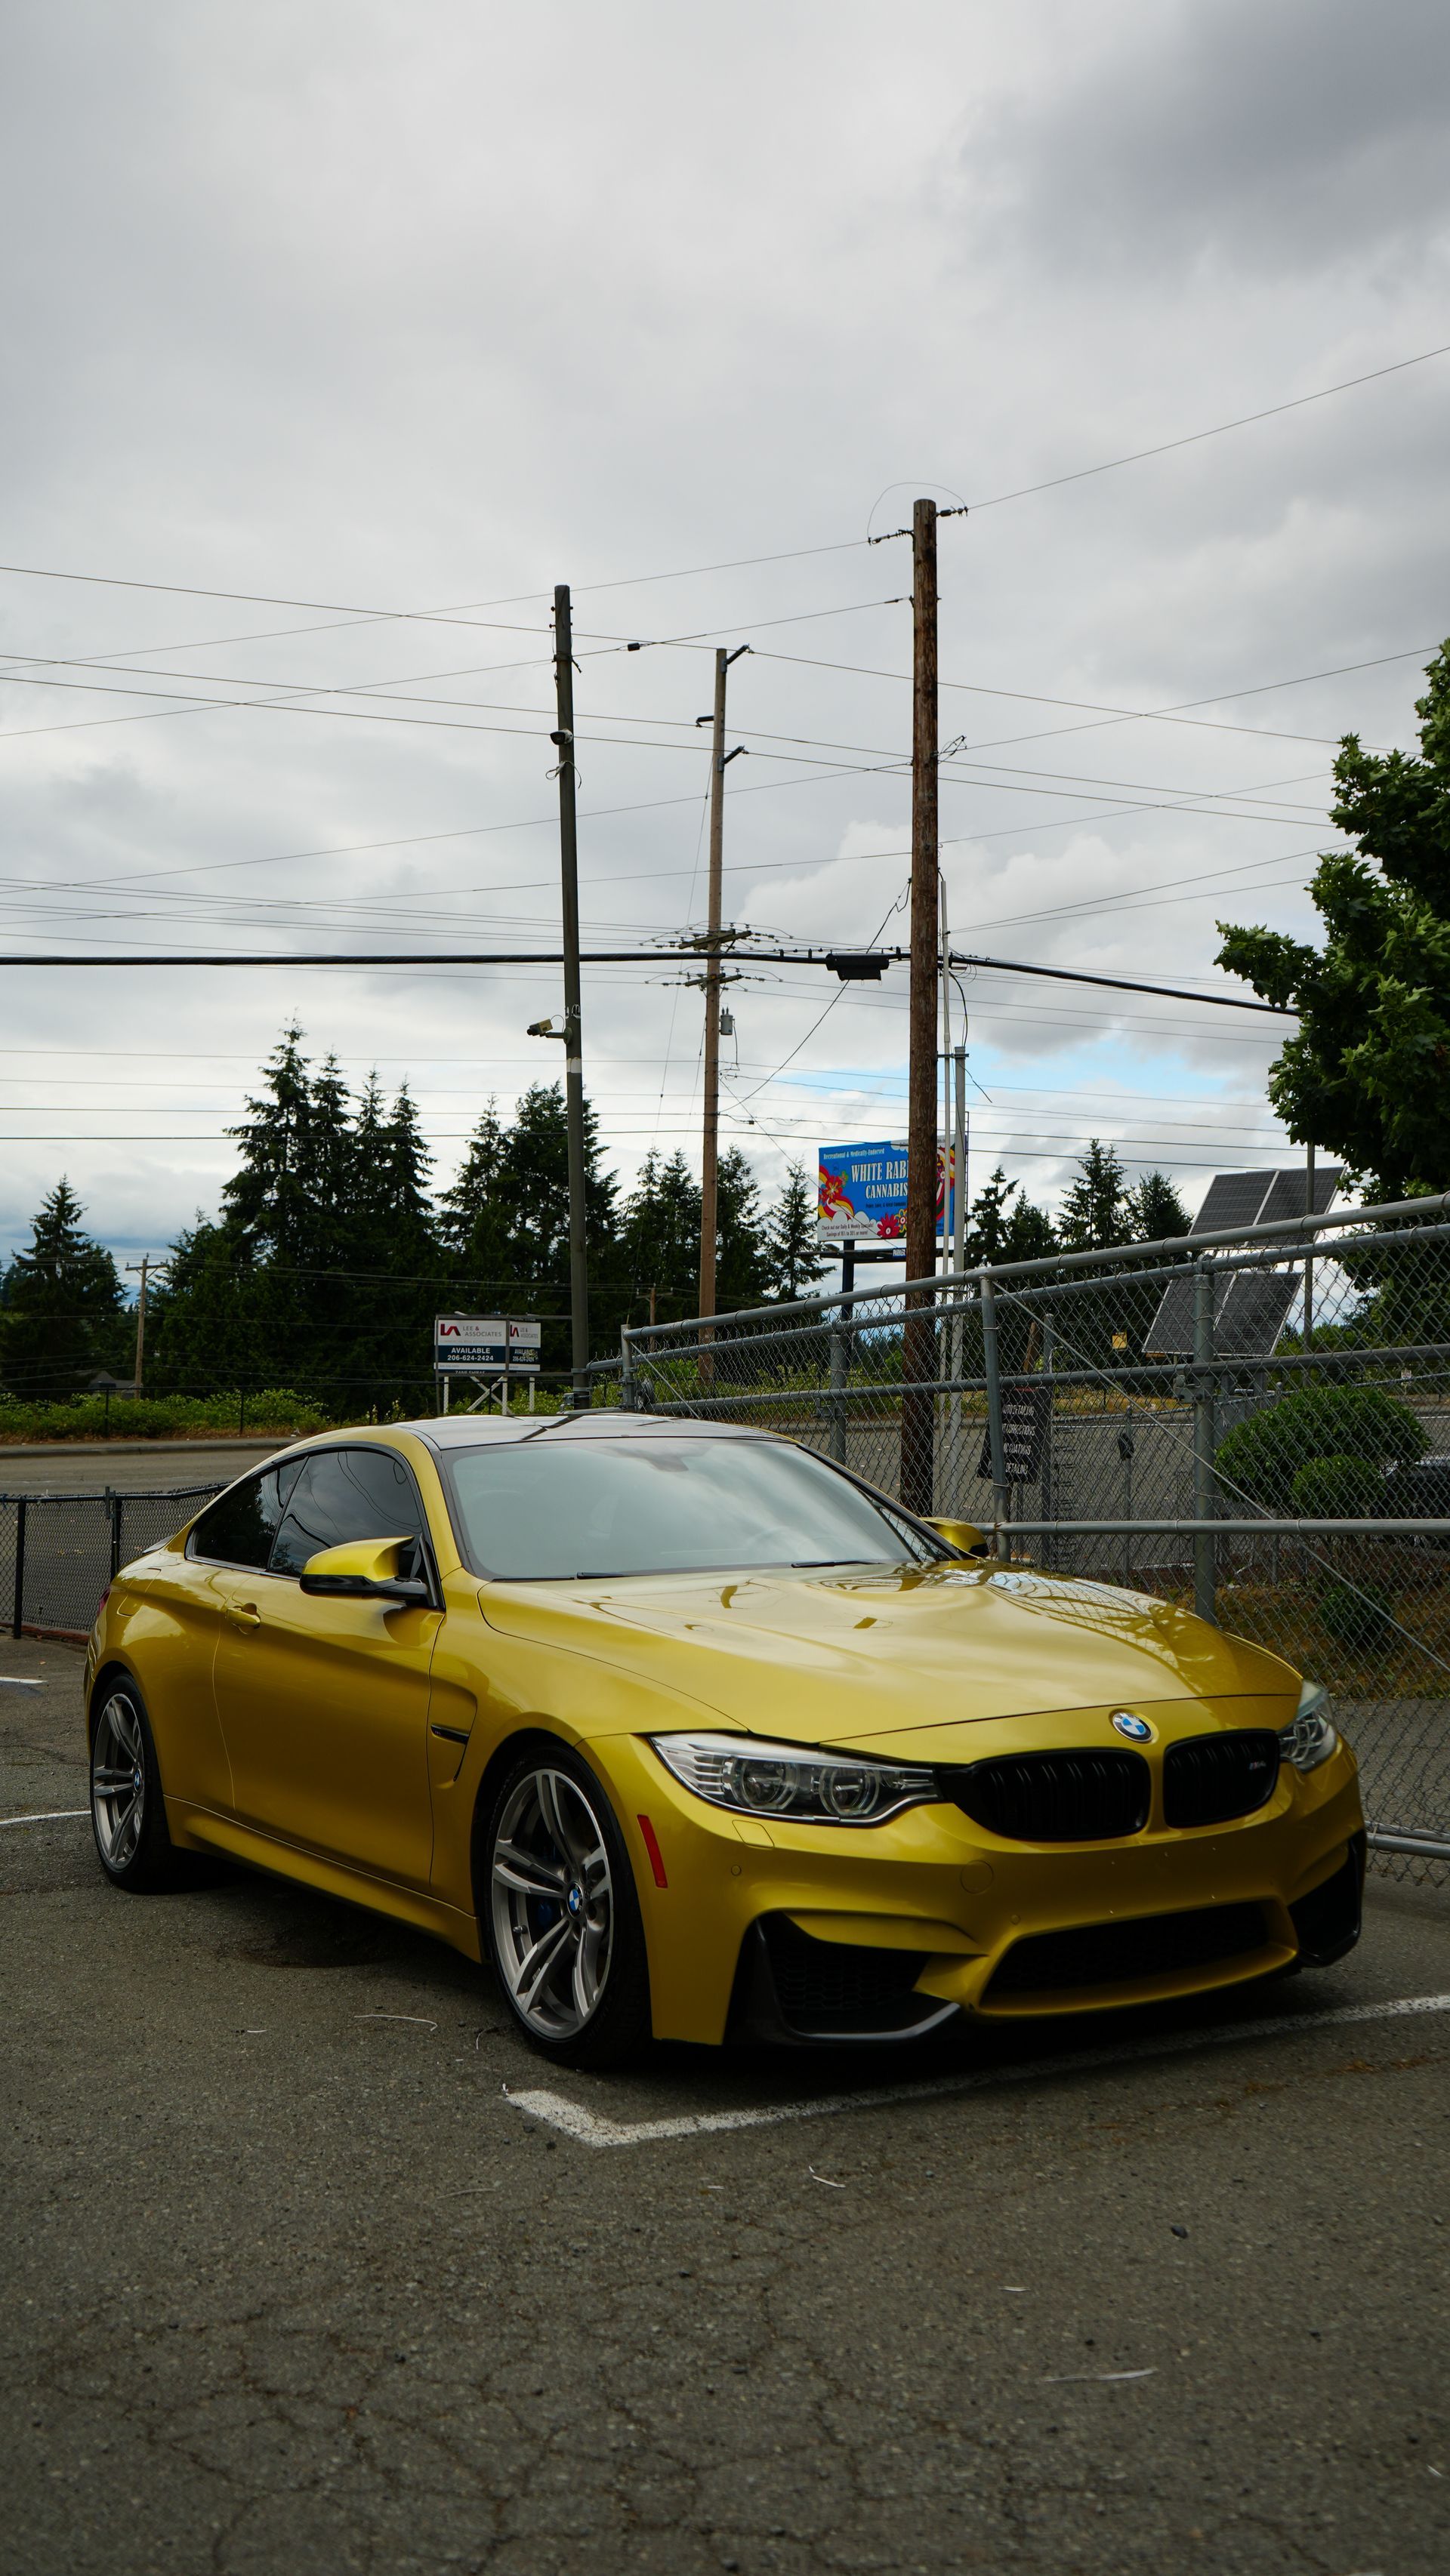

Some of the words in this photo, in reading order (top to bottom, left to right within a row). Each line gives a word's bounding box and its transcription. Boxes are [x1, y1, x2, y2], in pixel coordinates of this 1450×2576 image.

[823, 1151, 846, 1160] Recreational
[851, 1163, 882, 1183] WHITE
[886, 1160, 909, 1180] RAB
[865, 1182, 909, 1199] CANNABIS
